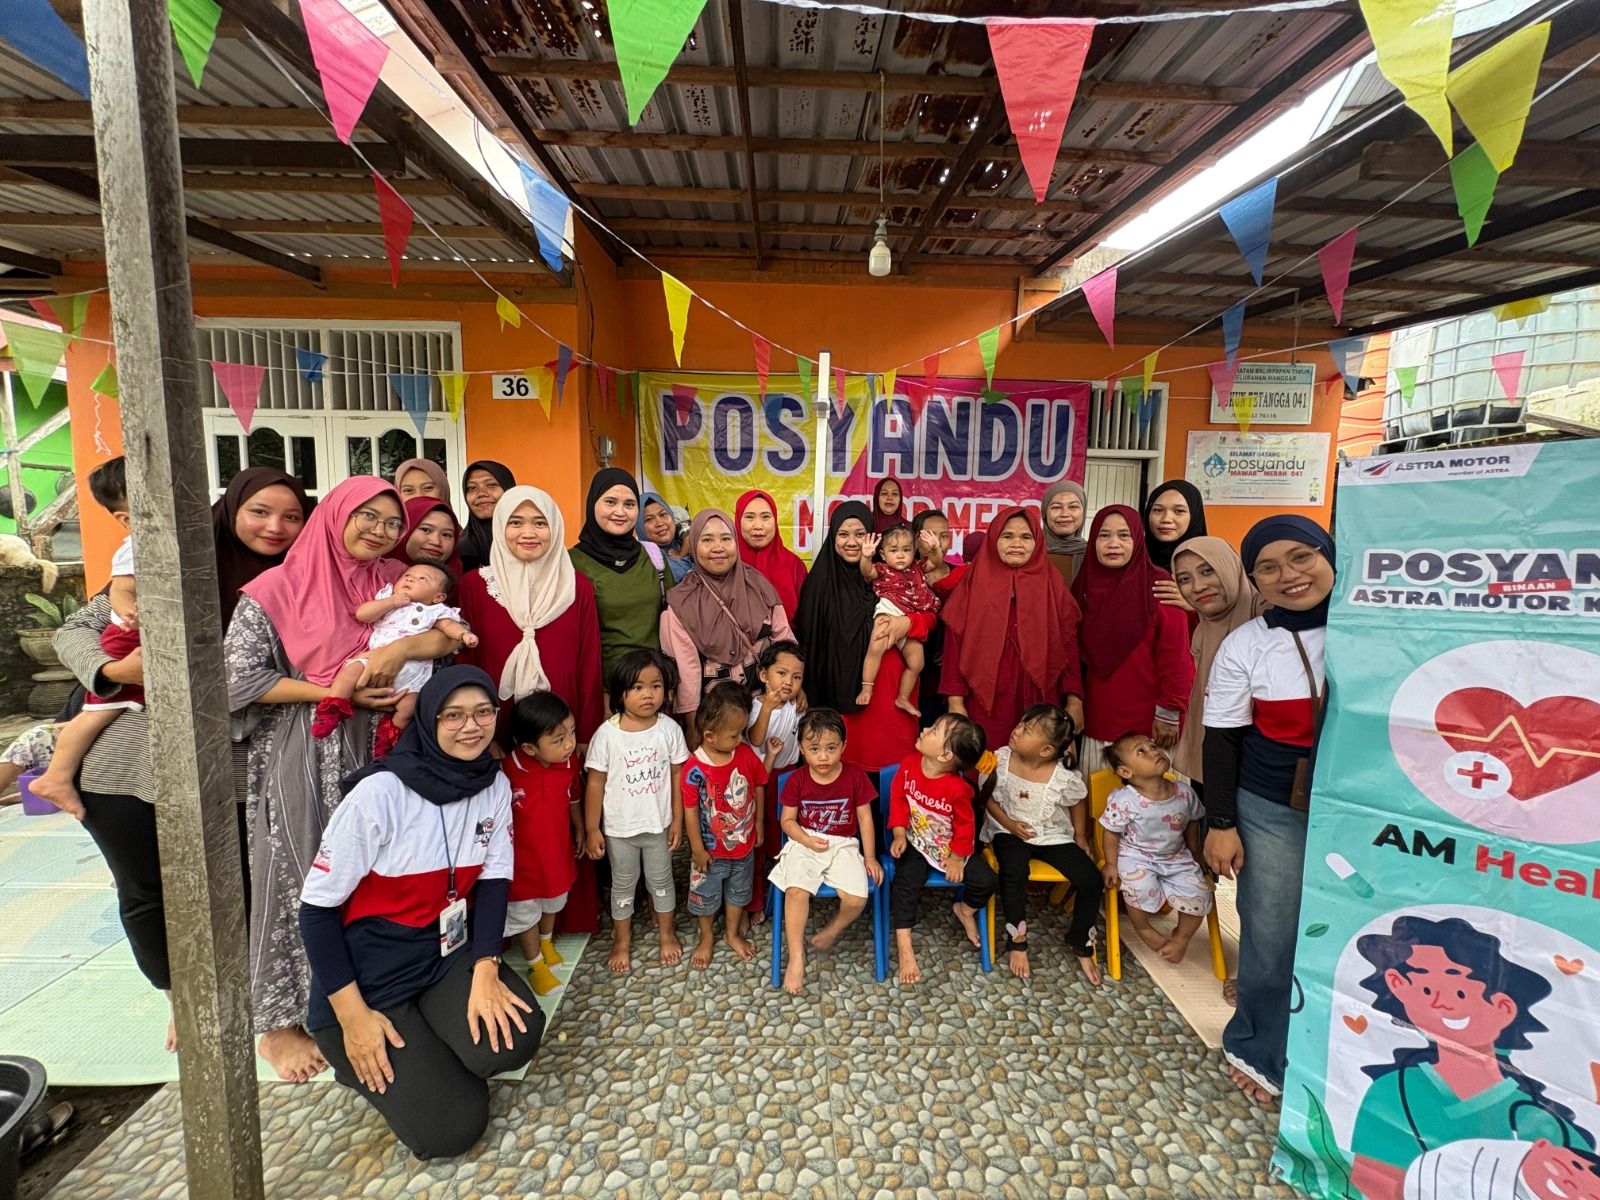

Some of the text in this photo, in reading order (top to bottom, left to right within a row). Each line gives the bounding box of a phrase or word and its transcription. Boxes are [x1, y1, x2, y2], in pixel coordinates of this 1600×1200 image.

[502, 378, 529, 397] 36
[1292, 392, 1307, 408] 041
[660, 392, 1072, 481] POSYANDU
[1228, 456, 1305, 473] posyandu
[1395, 456, 1510, 471] ASTRA MOTOR
[1502, 582, 1556, 592] BINAAN
[1353, 589, 1443, 606] ASTRA
[1454, 592, 1571, 611] MOTOR
[624, 749, 658, 768] best
[626, 766, 661, 784] little
[1372, 823, 1456, 865] AM
